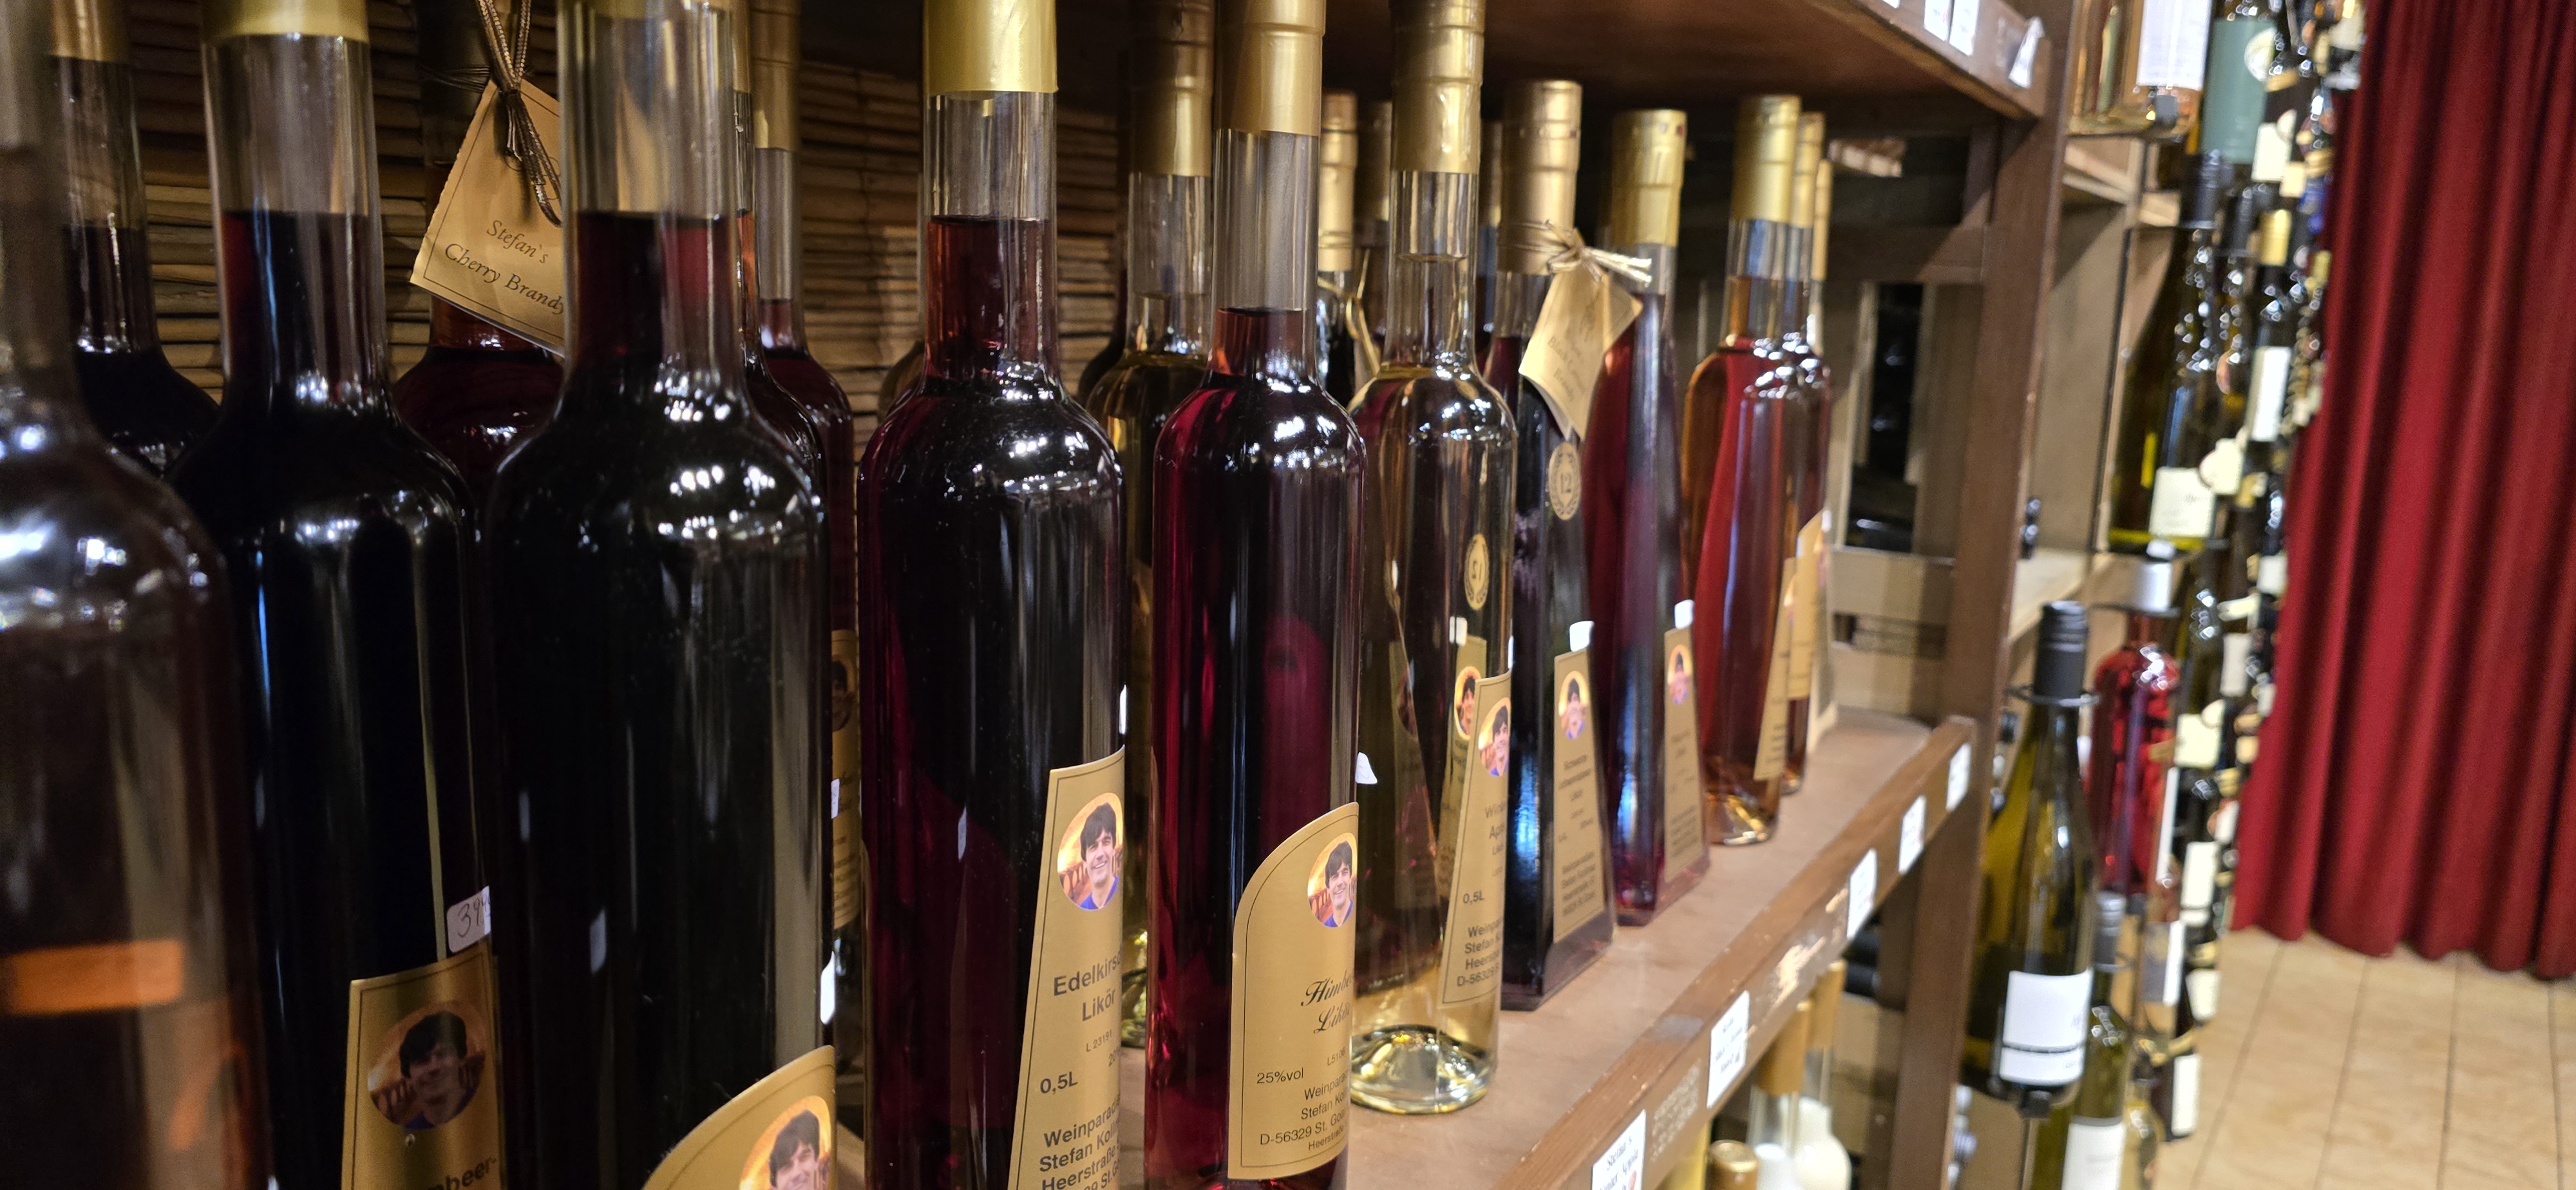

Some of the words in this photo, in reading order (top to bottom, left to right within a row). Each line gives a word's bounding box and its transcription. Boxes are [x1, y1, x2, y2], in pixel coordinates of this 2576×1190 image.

[445, 243, 502, 284] Cherry
[1559, 473, 1573, 495] 12
[1082, 988, 1116, 1021] Likör
[1086, 1043, 1091, 1052] L
[1093, 1029, 1112, 1049] 23191
[1039, 1071, 1078, 1095] 0,5L
[1256, 1067, 1304, 1084] 25%vol
[1301, 1100, 1332, 1120] Stefan
[1260, 1126, 1311, 1146] D-56329
[1039, 1143, 1093, 1173] Stefan
